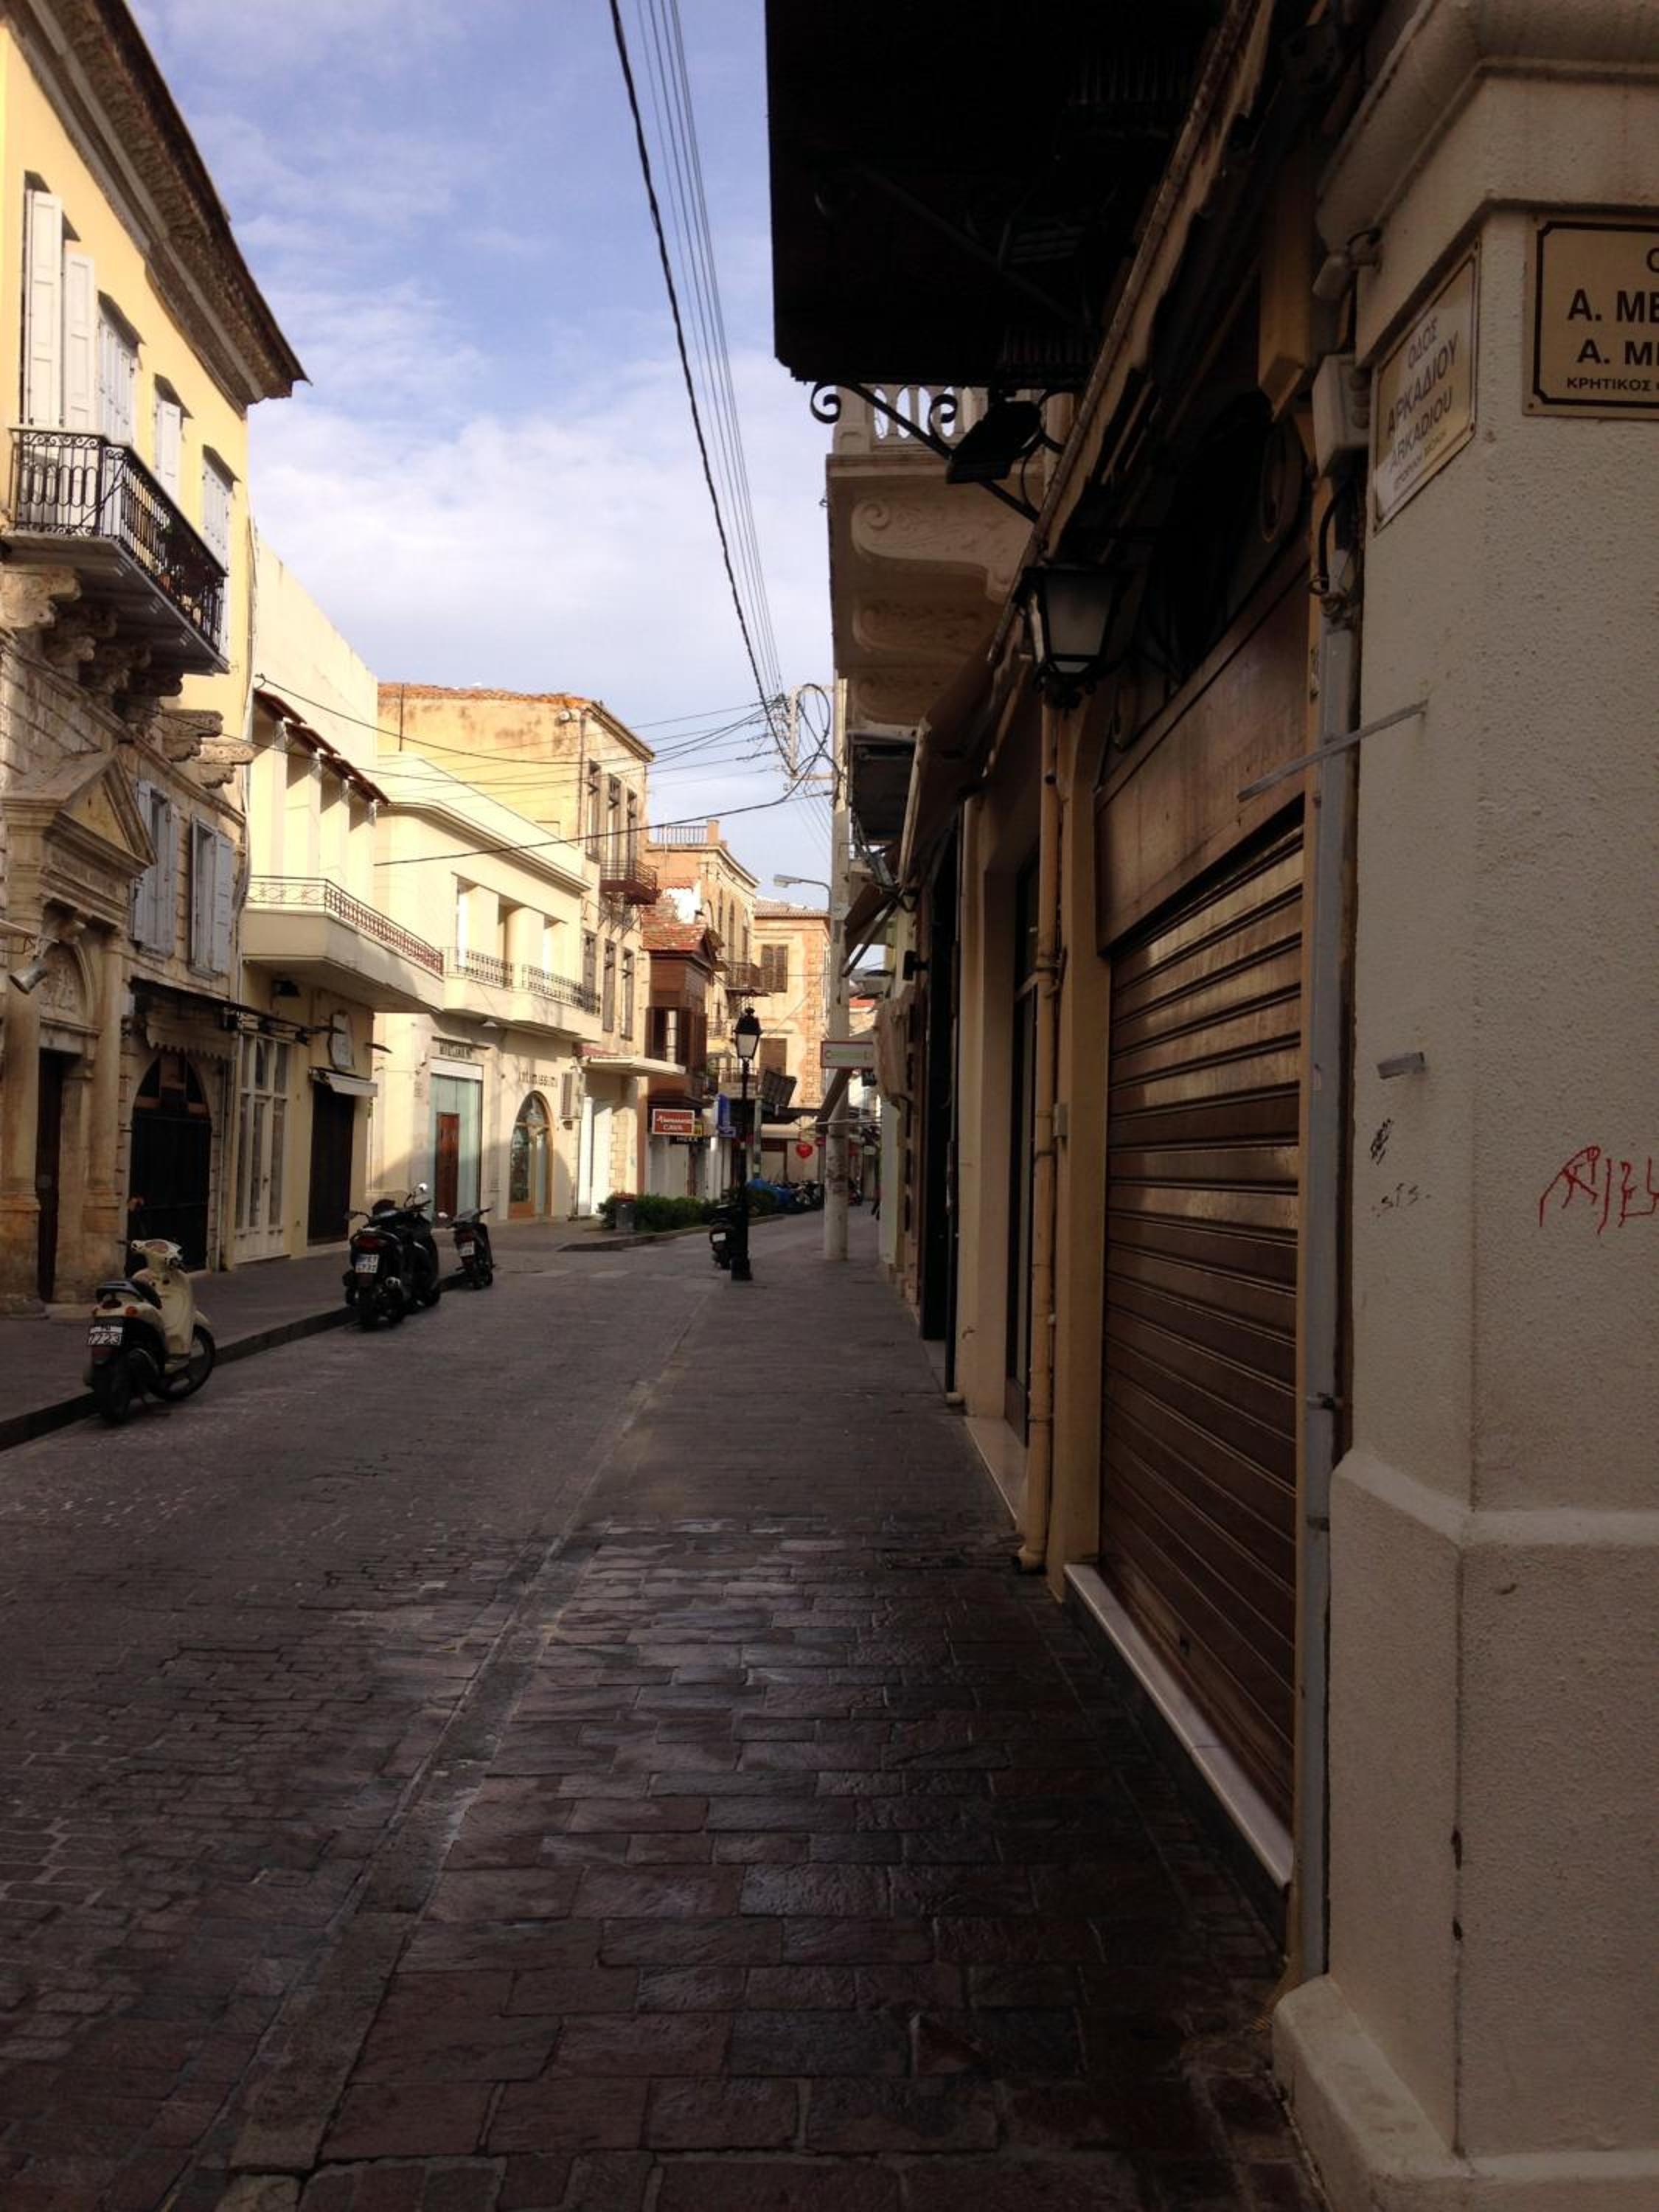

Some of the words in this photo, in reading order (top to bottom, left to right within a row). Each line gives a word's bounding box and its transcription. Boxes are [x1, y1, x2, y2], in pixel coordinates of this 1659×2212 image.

[1567, 288, 1602, 321] Α.
[1408, 317, 1439, 369] ΟΔΟΣ
[1576, 338, 1610, 364] A.
[1624, 340, 1659, 366] M
[1386, 330, 1458, 439] ΑΡΚΑΔΙΟΥ
[1566, 377, 1652, 392] ΚΡΗΤΙΚΟΣ
[1389, 386, 1453, 473] ARKADIOU
